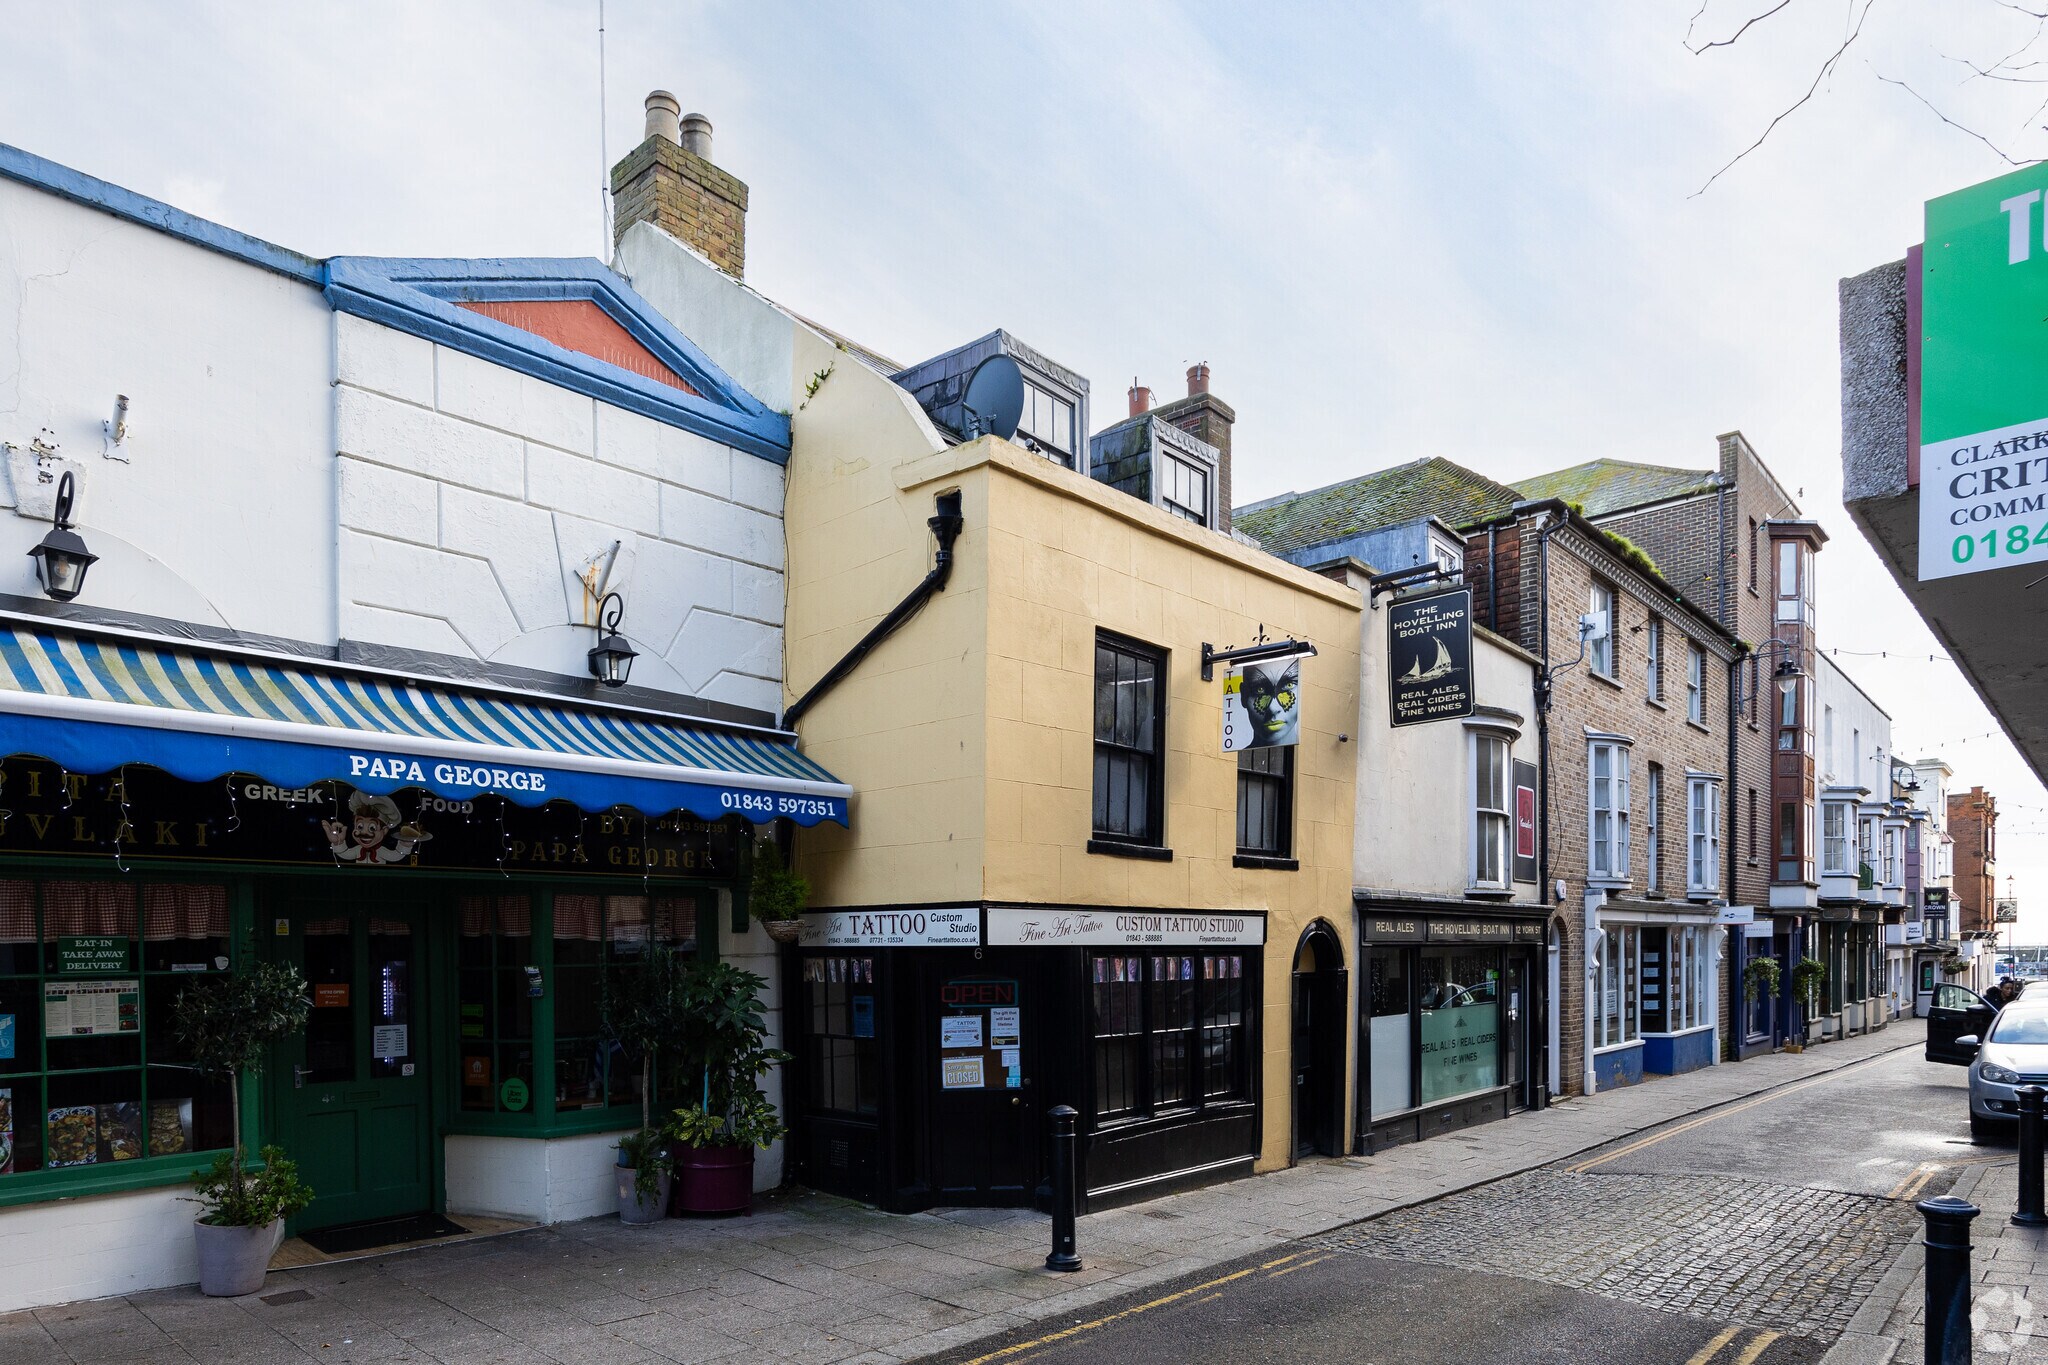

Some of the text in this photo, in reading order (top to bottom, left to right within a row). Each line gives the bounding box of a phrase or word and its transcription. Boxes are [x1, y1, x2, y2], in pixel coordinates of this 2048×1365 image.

[2000, 189, 2048, 265] T
[1394, 609, 1465, 630] HOVELLING
[1413, 605, 1439, 617] THE
[1399, 620, 1458, 638] BOAT INN
[1397, 692, 1466, 710] REAL CIDERS
[1401, 684, 1460, 700] REAL ALES
[1223, 670, 1234, 749] TATTOO
[1401, 702, 1462, 718] FINE WINES
[349, 755, 546, 792] PAPA GEORGE
[244, 784, 474, 815] GREEK FOOD
[720, 792, 836, 816] 01843 597351
[0, 809, 209, 847] VLAKI
[600, 814, 633, 836] BY
[511, 840, 715, 869] PAPA GEORGE
[800, 912, 963, 942] Fine Art TATTOO Custom
[949, 923, 978, 933] Studio
[1018, 913, 1244, 943] Fine Art Tattoo CUSTOM TATTOO STUDIO
[1375, 921, 1415, 933] REAL ALES
[1429, 924, 1510, 935] THE HOVELLING BOAT INN
[1515, 926, 1541, 934] 12 YORK ST
[74, 939, 113, 948] EAT-IN
[62, 950, 126, 959] TAKE AWAY
[974, 948, 983, 959] 6
[66, 961, 123, 970] DELIVERY
[941, 984, 1014, 1003] OPEN
[1421, 1042, 1438, 1053] REAL
[1460, 1036, 1475, 1047] REAL
[1476, 1033, 1497, 1044] CIDERS
[1459, 1052, 1478, 1064] WINES
[947, 1071, 979, 1084] CLOSED
[507, 1089, 521, 1097] Uber
